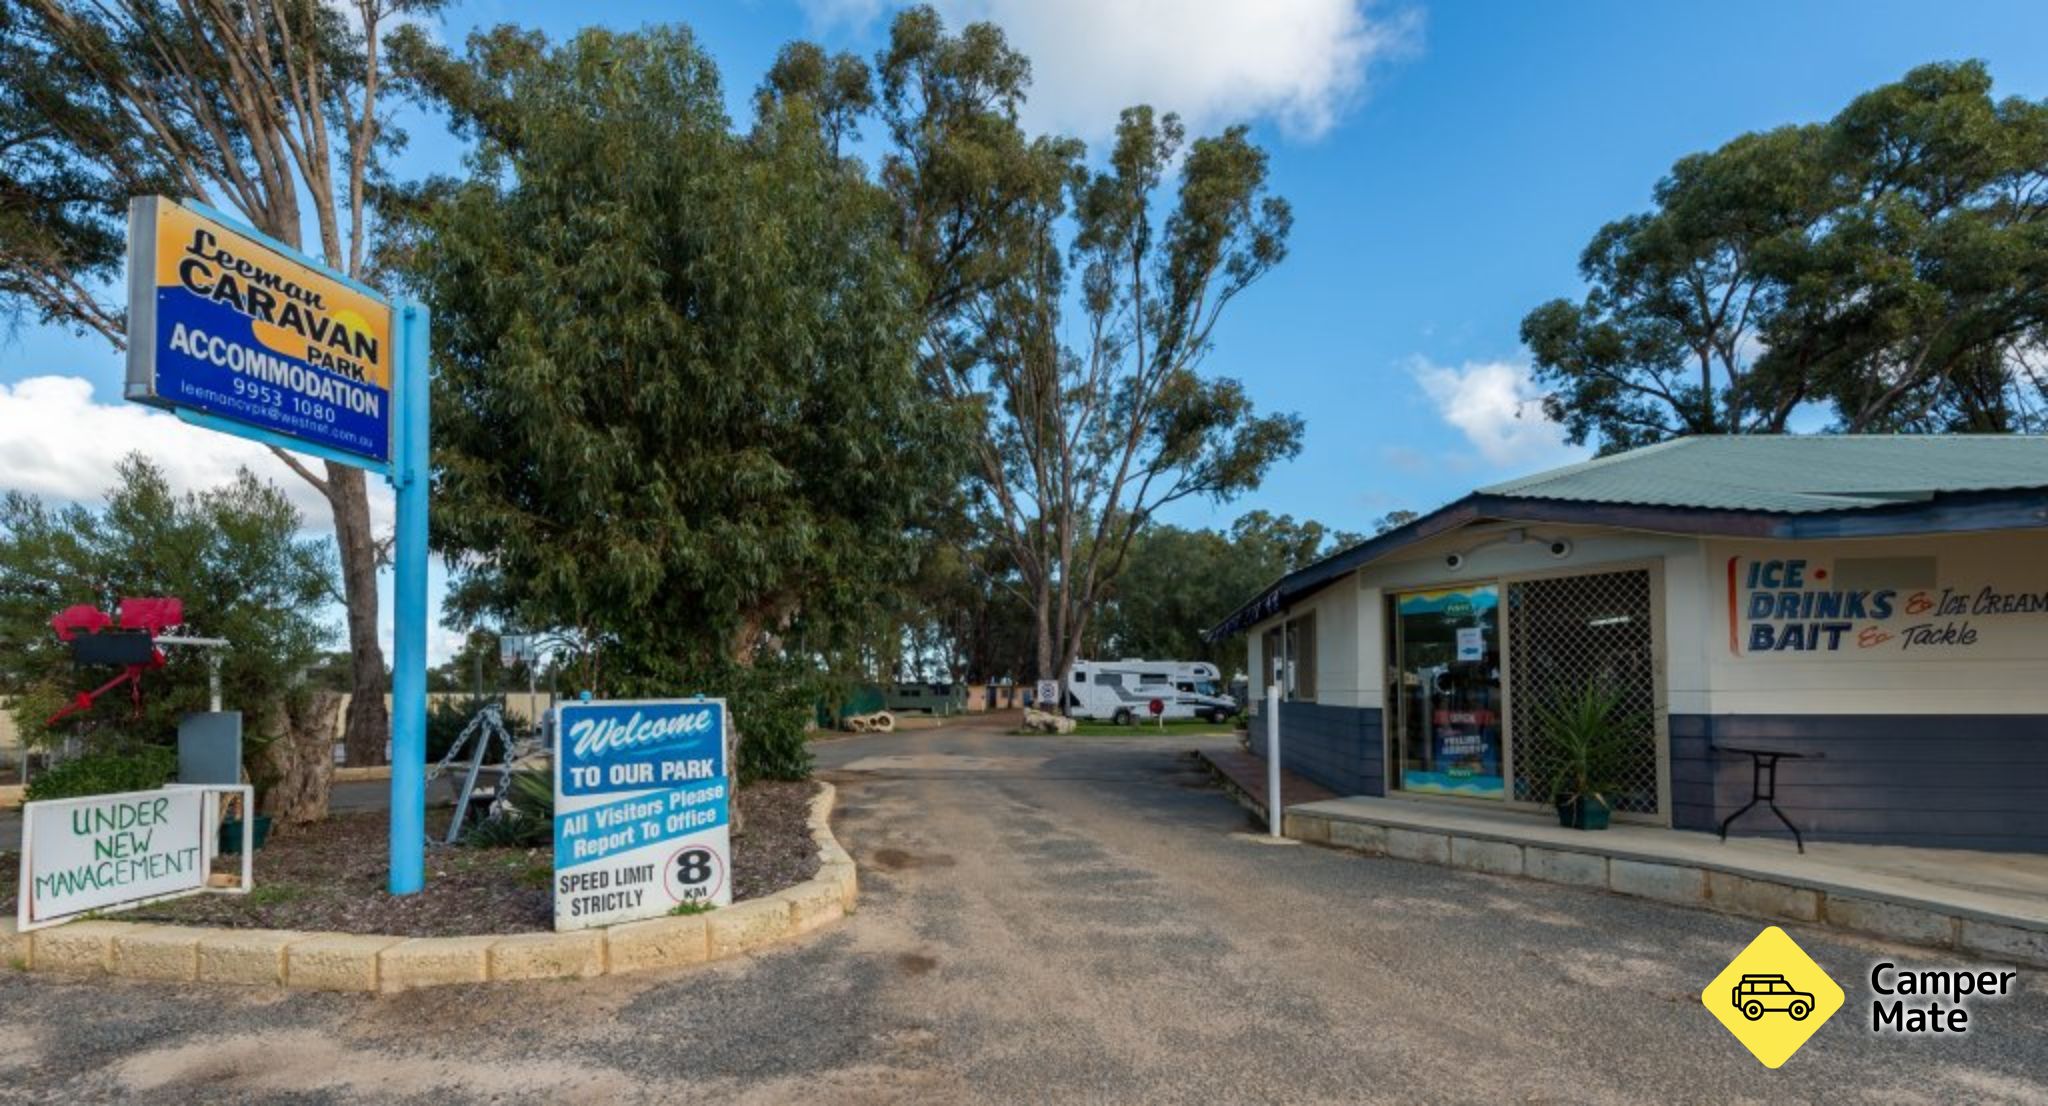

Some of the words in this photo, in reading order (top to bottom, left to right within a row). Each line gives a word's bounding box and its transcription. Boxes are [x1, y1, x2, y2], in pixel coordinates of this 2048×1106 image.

[186, 229, 326, 310] Leeman
[179, 258, 379, 365] CARAVAN
[169, 323, 379, 419] ACCOMMODATION
[307, 345, 365, 381] PARK
[233, 378, 282, 407] 9953
[294, 397, 336, 424] 1080
[1747, 560, 1806, 589] ICE
[1747, 590, 1897, 620] DRINKS
[1934, 588, 1970, 617] ICE
[1972, 586, 2048, 614] CREAM
[1748, 623, 1852, 652] BAIT
[1901, 621, 1978, 651] Tackle
[569, 709, 711, 759] Welcome
[571, 765, 600, 788] TO
[609, 761, 654, 785] OUR
[661, 758, 714, 782] PARK
[73, 797, 170, 836] UNDER
[562, 813, 588, 838] All
[595, 799, 664, 829] Visitors
[669, 784, 724, 811] Please
[94, 829, 153, 862] NEW
[573, 826, 635, 859] Report
[641, 820, 661, 840] To
[666, 807, 717, 834] Office
[35, 847, 199, 900] MANAGEMENT
[559, 870, 609, 895] SPEED
[615, 864, 655, 886] LIMIT
[677, 849, 712, 885] 8
[571, 889, 643, 917] STRICTLY
[683, 886, 707, 900] KM
